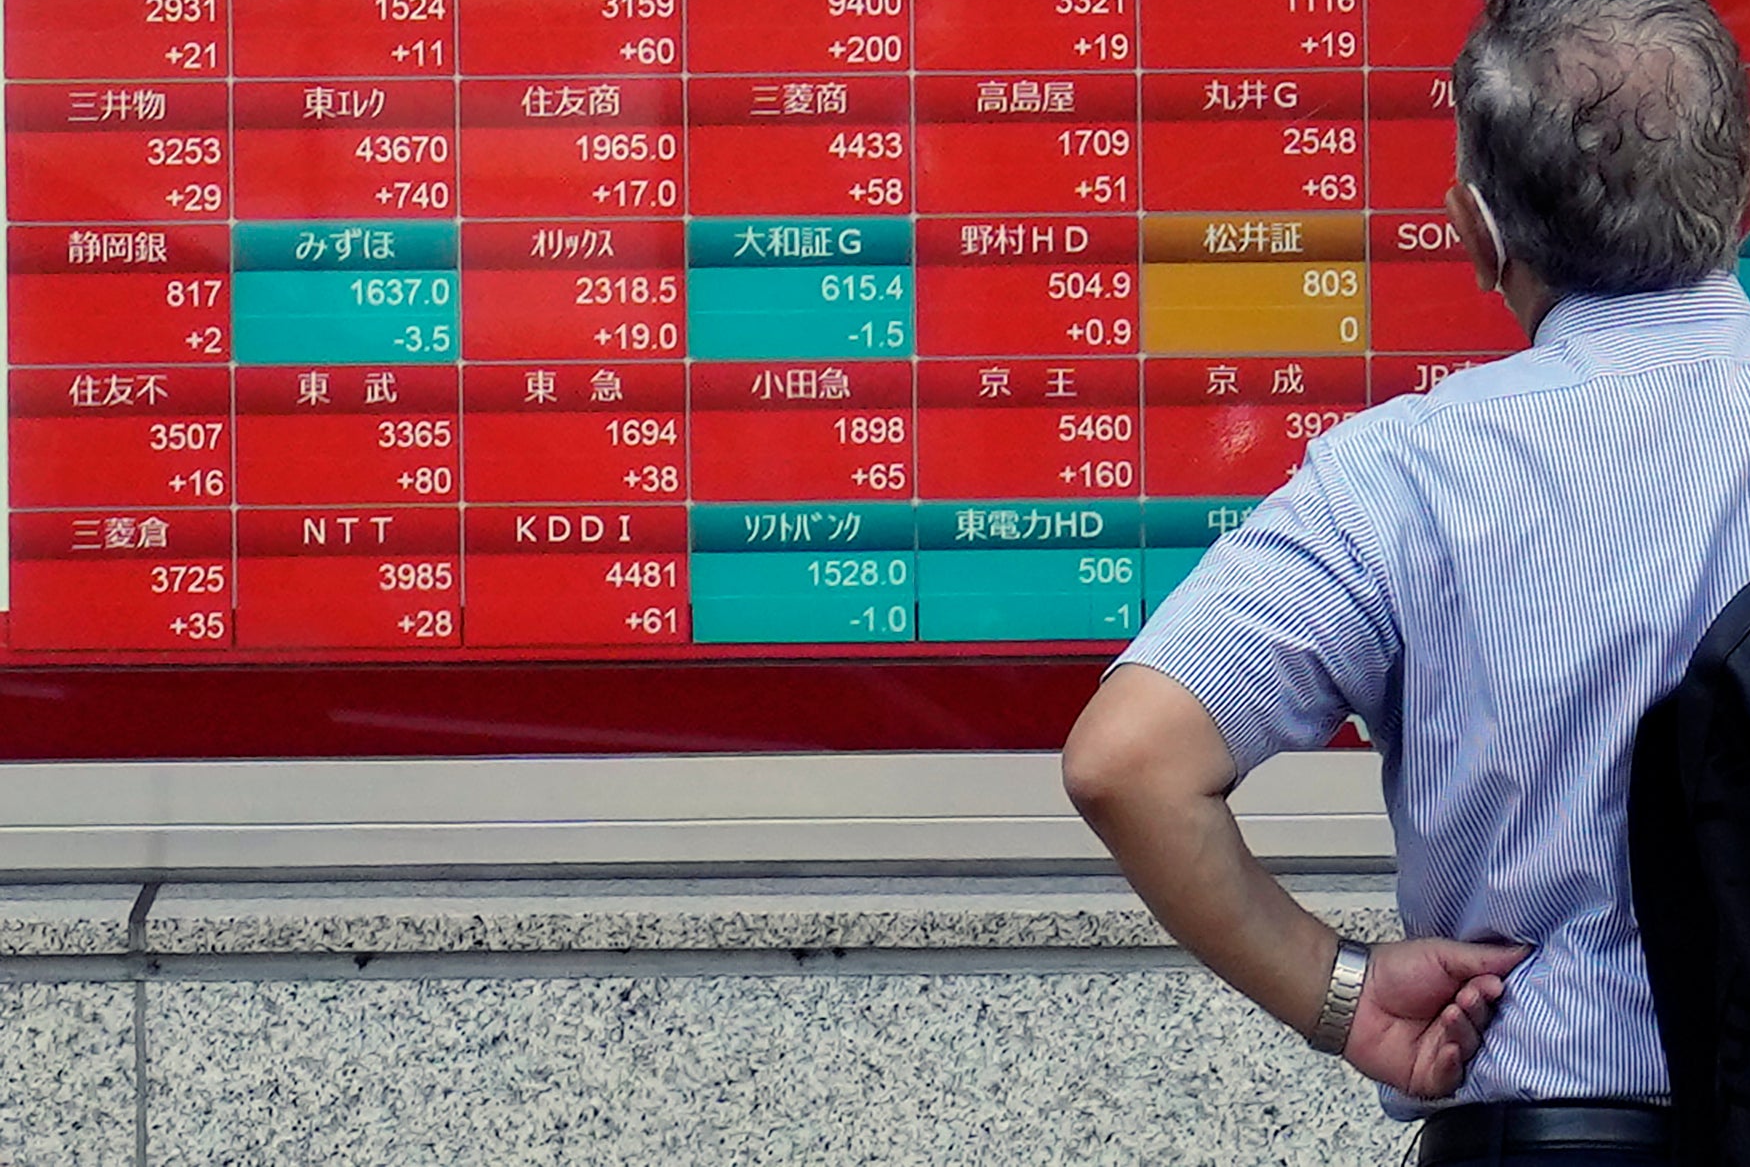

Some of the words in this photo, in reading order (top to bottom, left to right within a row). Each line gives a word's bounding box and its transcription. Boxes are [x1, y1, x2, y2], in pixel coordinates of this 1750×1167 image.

[390, 38, 443, 67] +11
[1073, 32, 1130, 61] +19
[67, 88, 167, 122] 三井物
[146, 136, 223, 166] 3253
[1282, 126, 1358, 156] 2548
[164, 183, 223, 212] +29
[1301, 173, 1358, 202] +63
[294, 229, 396, 262] みずほ
[1202, 221, 1305, 255] 松井証
[349, 277, 451, 307] 1637.0
[1301, 268, 1359, 298] 803
[392, 324, 451, 353] -3.5
[1339, 314, 1360, 344] 0
[750, 368, 852, 401] 小田急
[833, 415, 906, 445] 1898
[850, 462, 907, 491] +65
[71, 516, 170, 551] 三菱倉
[150, 564, 226, 594] 3725
[1078, 556, 1134, 585] 506
[168, 611, 226, 641] +35
[1103, 602, 1130, 630] -1
